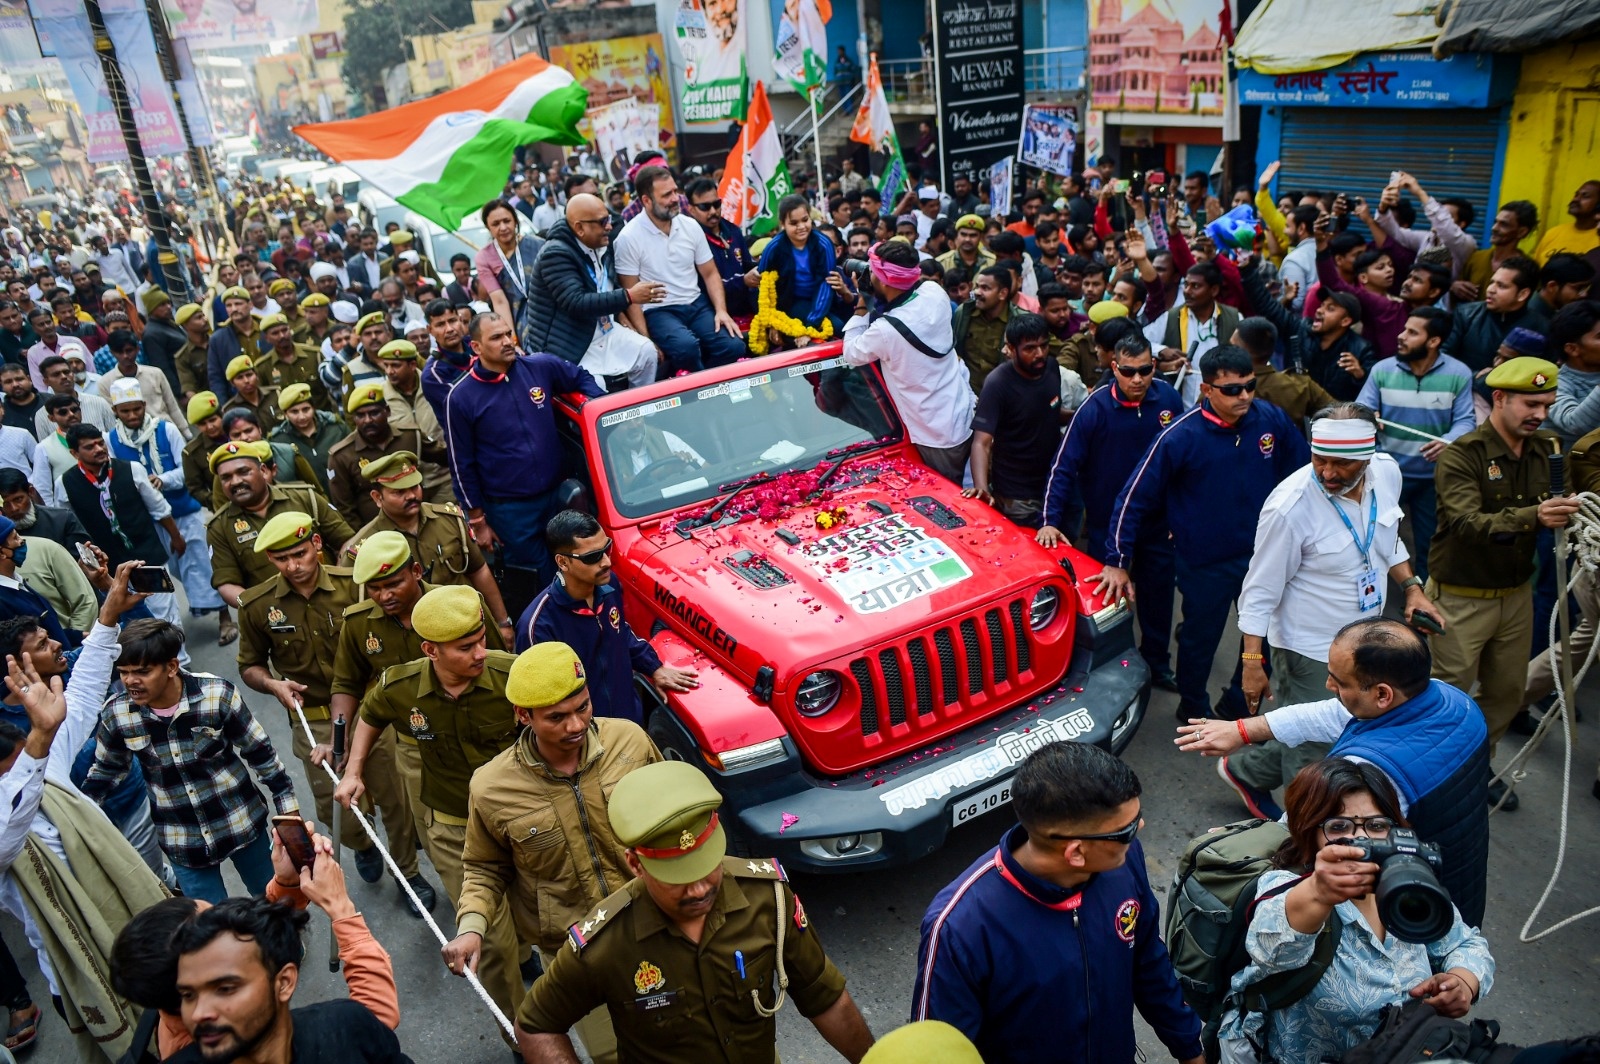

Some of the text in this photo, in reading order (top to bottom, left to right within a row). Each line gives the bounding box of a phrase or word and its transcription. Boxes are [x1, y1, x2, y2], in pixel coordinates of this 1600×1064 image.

[949, 21, 1013, 36] MULTICUISINE
[948, 33, 1015, 49] RESTAURANT
[951, 59, 1015, 83] MEWAR
[1335, 61, 1399, 95] स्टोर
[962, 79, 1005, 92] BANQUET
[948, 110, 1019, 132] Vrindavan
[965, 127, 1006, 140] BANQUET
[602, 412, 625, 426] BHARAT
[624, 408, 641, 420] JODO
[655, 400, 672, 411] YATRA
[850, 569, 933, 611] यात्रा
[653, 581, 738, 659] WRANGLER
[1057, 709, 1092, 740] तक
[958, 803, 978, 821] CG
[982, 794, 998, 810] 10
[1396, 845, 1417, 853] Canon
